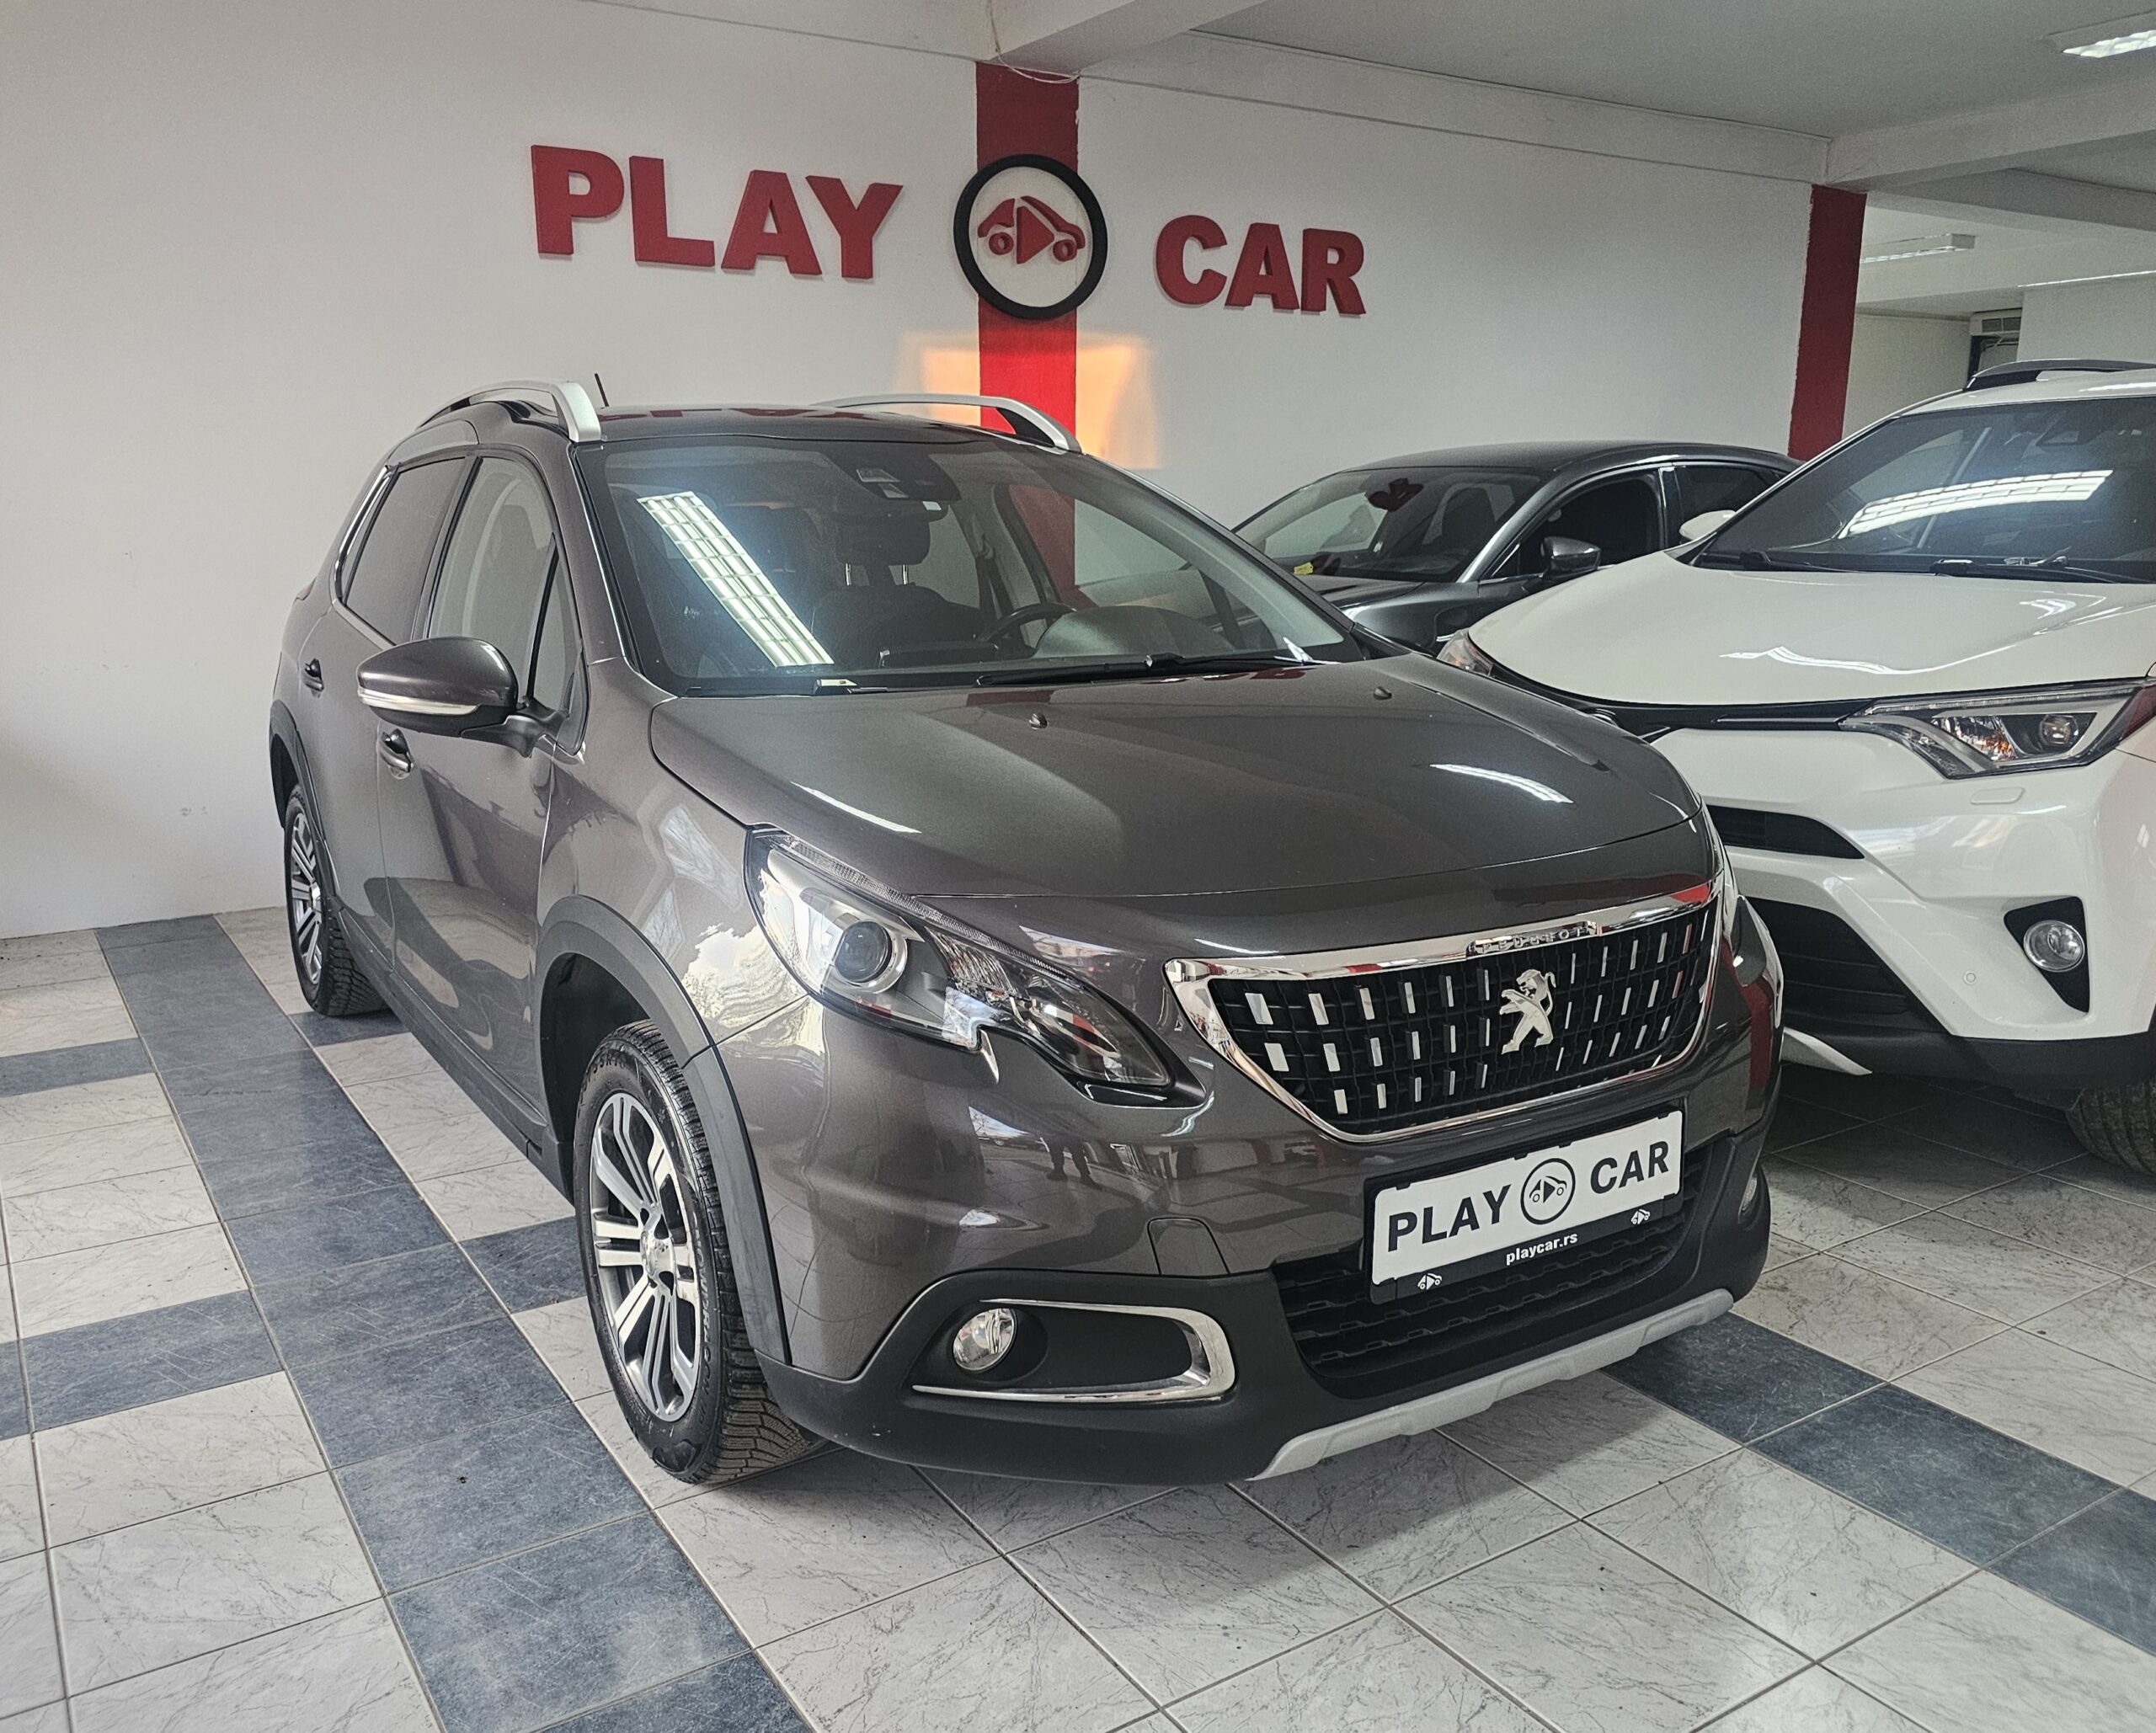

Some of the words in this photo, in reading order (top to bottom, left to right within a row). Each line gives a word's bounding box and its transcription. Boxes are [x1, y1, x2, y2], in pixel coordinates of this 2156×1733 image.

[531, 144, 904, 279] PLAY
[1155, 215, 1366, 315] CAR
[1387, 1184, 1512, 1252] PLAY
[1590, 1141, 1670, 1195] CAR
[1506, 1232, 1578, 1266] playcar.rs
